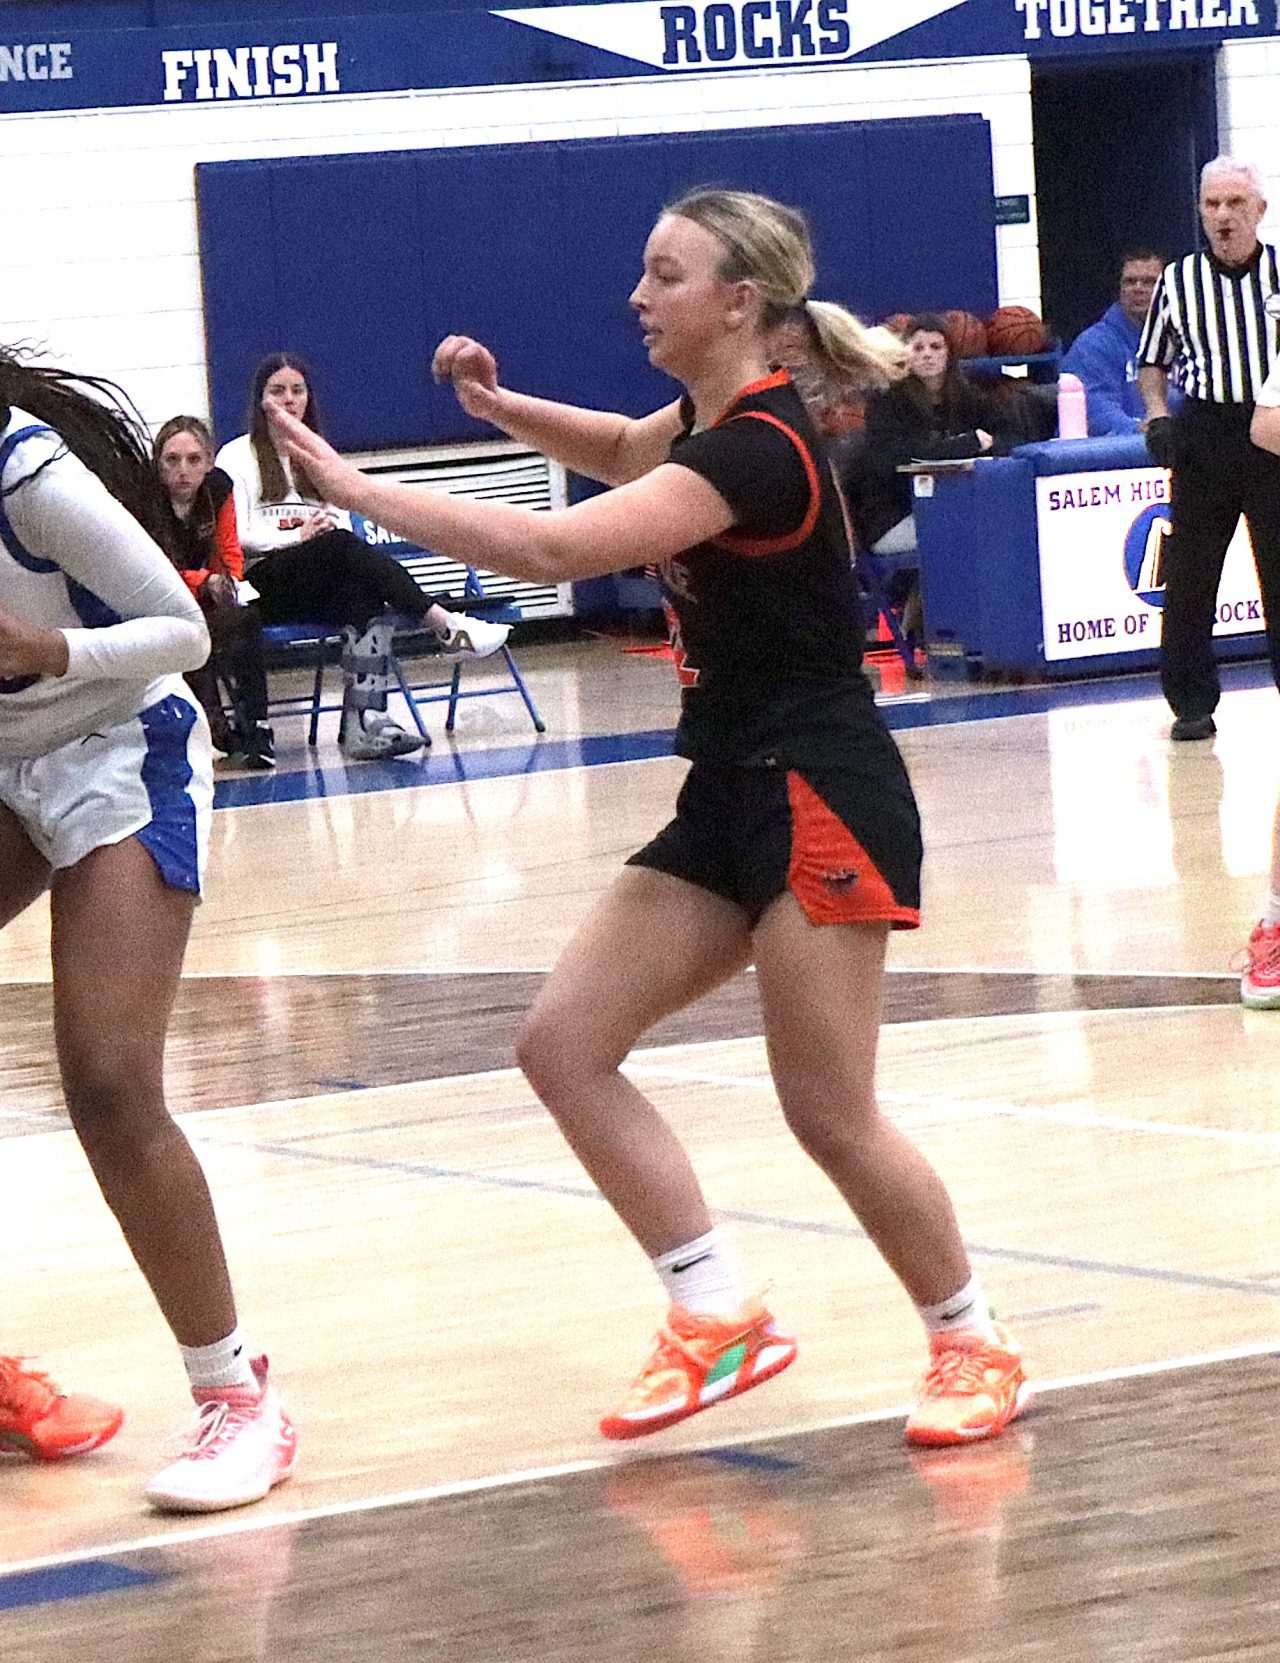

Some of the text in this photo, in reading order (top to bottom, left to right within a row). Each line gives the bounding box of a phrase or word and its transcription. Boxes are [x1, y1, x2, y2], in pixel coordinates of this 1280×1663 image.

[660, 0, 850, 64] ROCKS
[1015, 0, 1258, 39] TOGETHER
[162, 42, 340, 100] FINISH
[1048, 480, 1165, 511] SALEM HIG
[1058, 600, 1261, 643] HOME OF OCK
